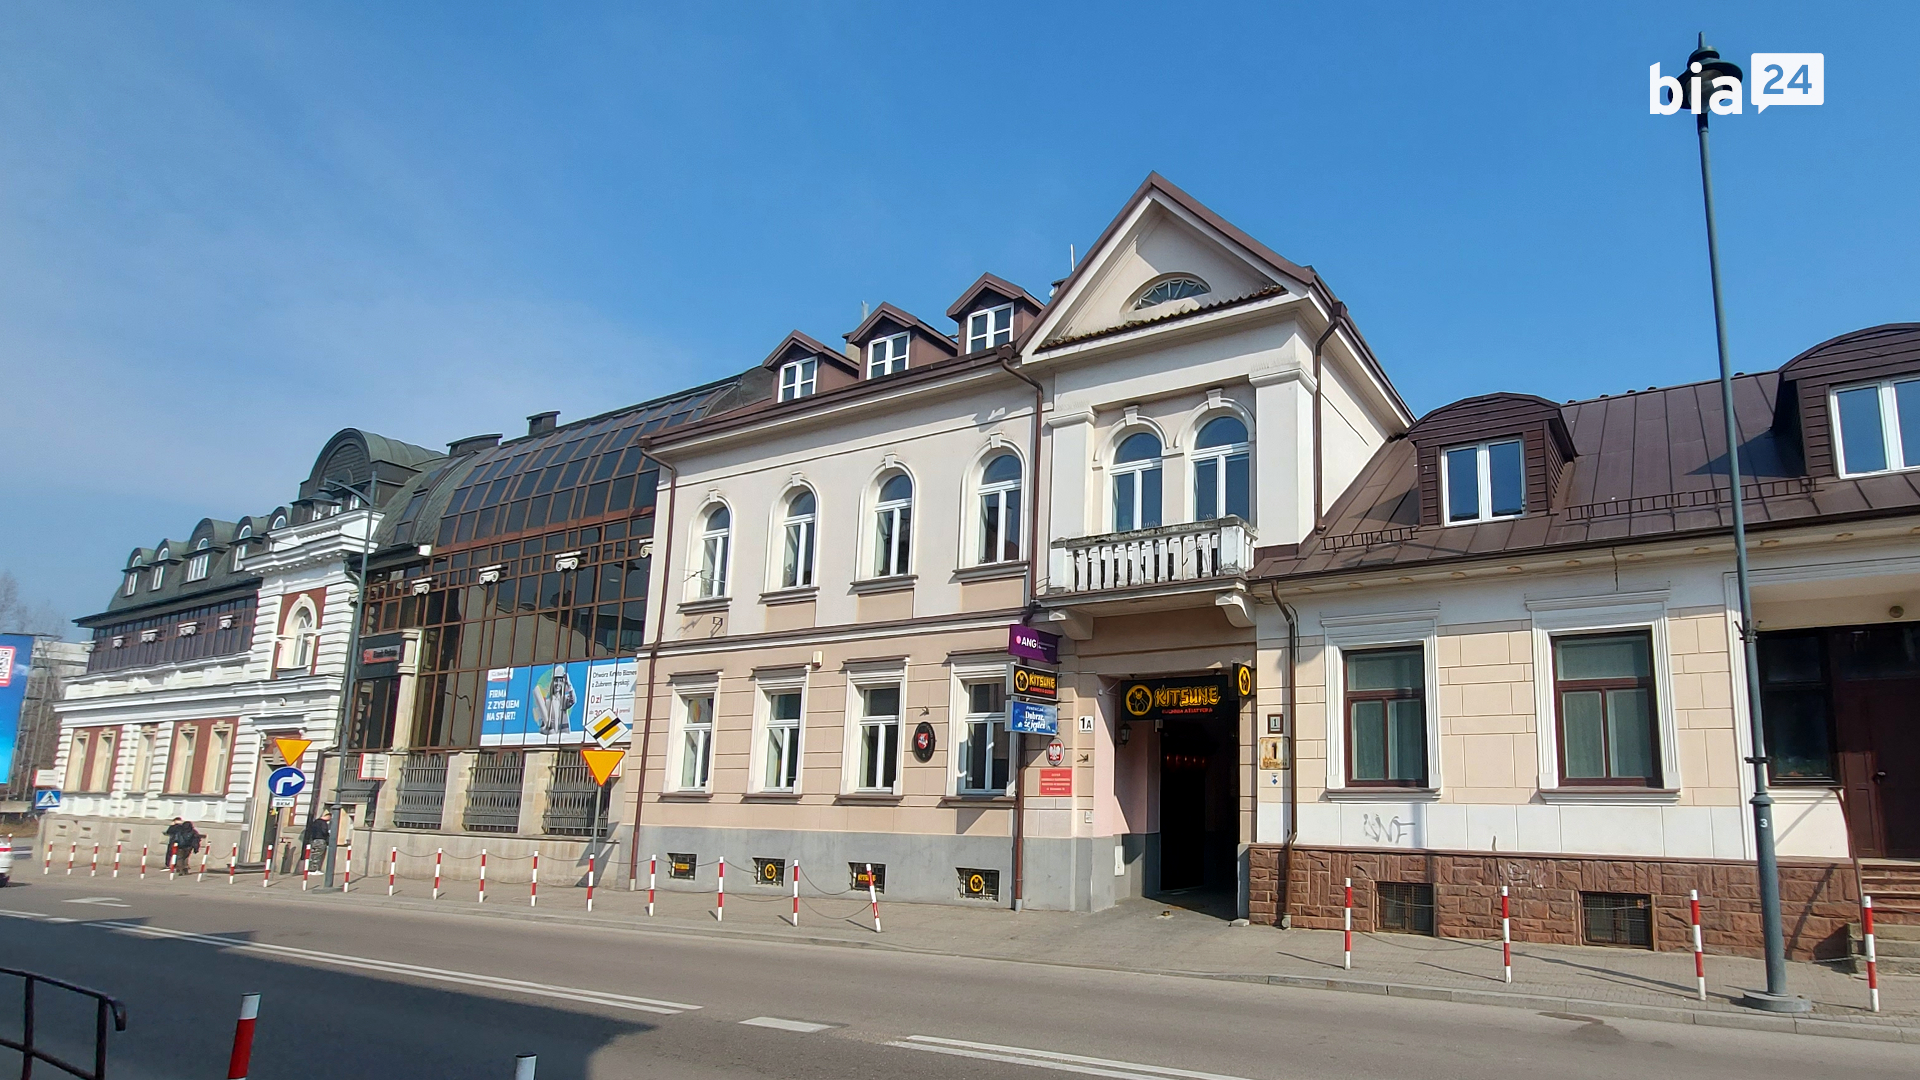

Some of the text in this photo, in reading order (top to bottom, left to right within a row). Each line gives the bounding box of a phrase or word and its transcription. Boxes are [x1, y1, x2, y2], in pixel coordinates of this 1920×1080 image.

[1021, 636, 1037, 649] ANG
[1029, 672, 1056, 690] KITSUNE
[1154, 685, 1221, 707] KITSUNE
[487, 701, 492, 709] Z
[486, 712, 495, 721] NA
[1080, 717, 1092, 729] 1A
[1272, 742, 1277, 759] 1
[1760, 818, 1768, 828] 3
